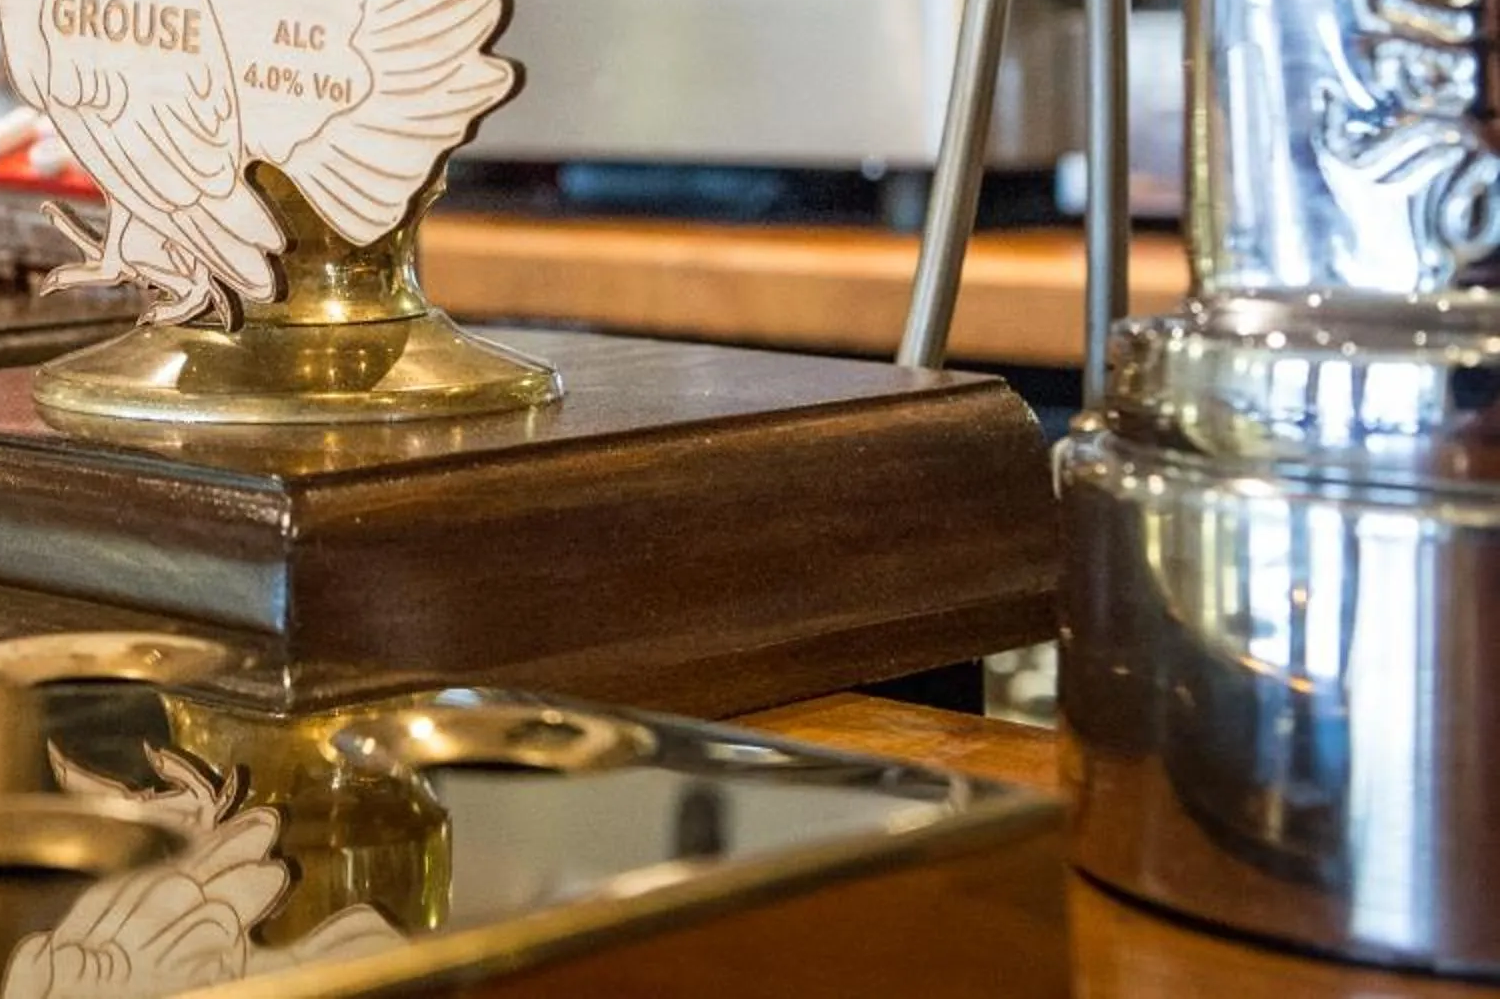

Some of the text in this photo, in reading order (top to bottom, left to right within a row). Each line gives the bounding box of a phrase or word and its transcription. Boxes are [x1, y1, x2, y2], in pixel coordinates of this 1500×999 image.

[273, 19, 325, 51] ALC
[243, 62, 352, 104] 4.0% Vol
